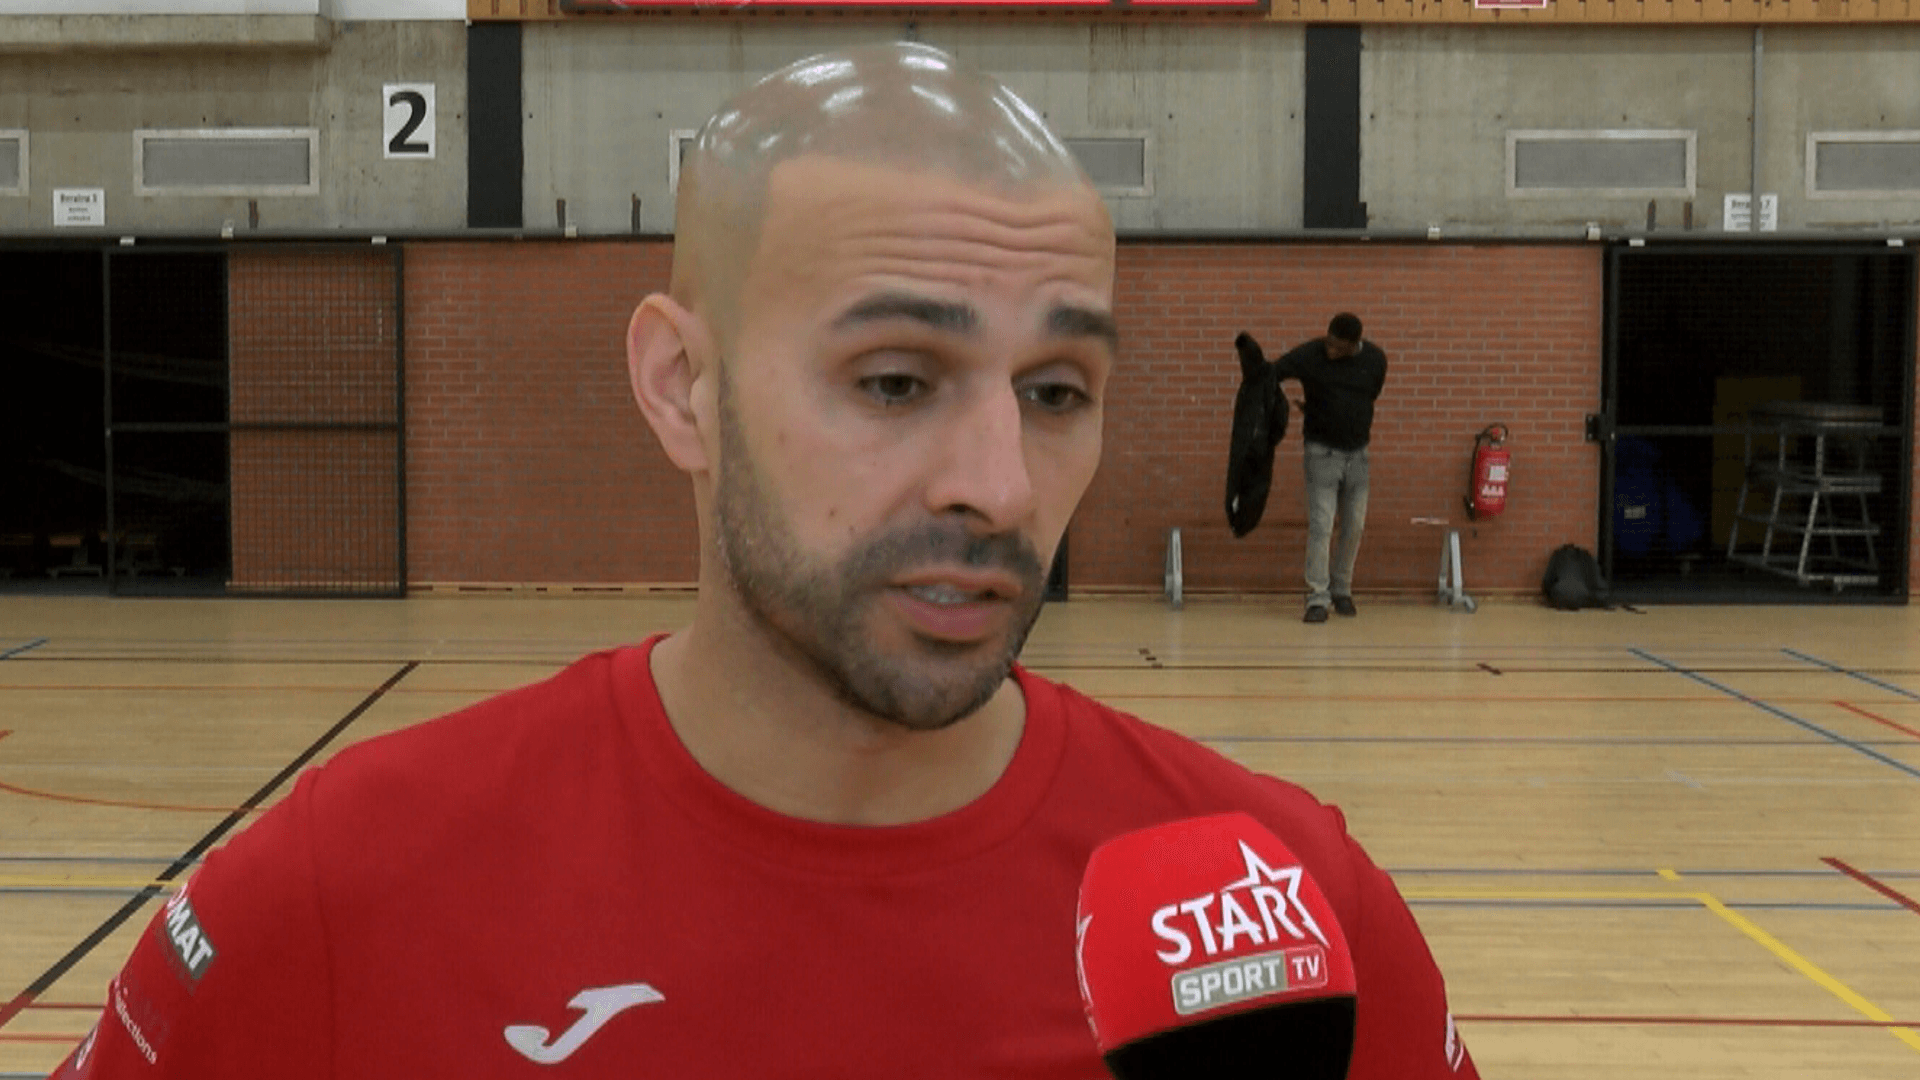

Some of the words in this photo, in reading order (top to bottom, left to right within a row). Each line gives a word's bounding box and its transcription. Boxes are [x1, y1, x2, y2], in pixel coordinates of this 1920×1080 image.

[388, 91, 429, 153] 2
[1151, 884, 1306, 966] STAR
[1179, 958, 1281, 1008] SPORT
[1292, 953, 1321, 980] TV
